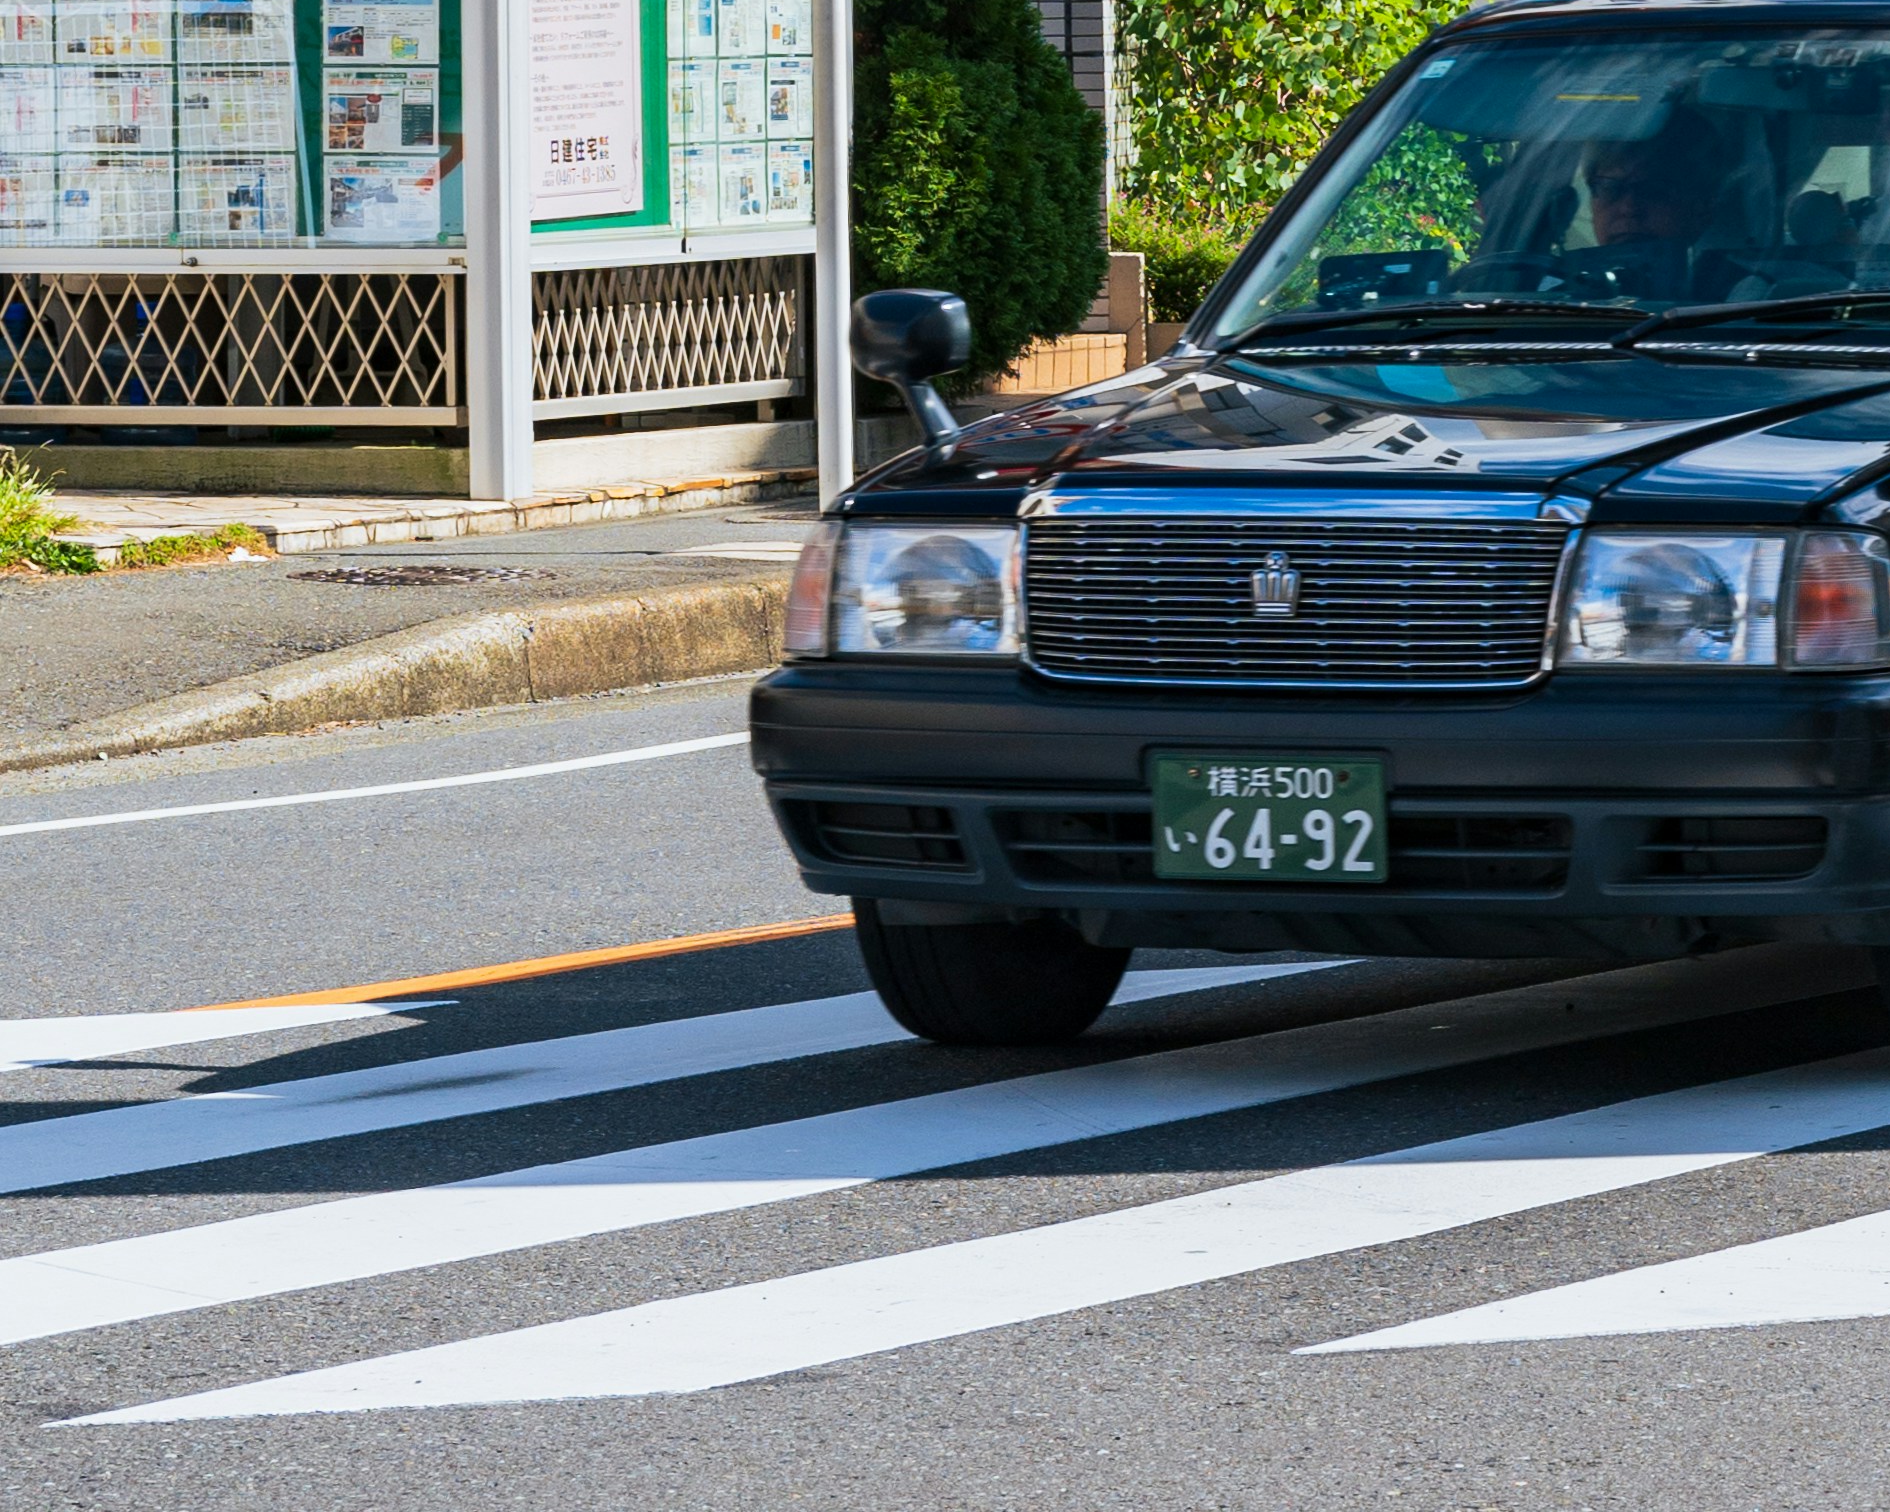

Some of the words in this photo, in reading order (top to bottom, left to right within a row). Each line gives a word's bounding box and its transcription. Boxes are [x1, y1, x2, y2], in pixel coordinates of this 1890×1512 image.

[1207, 766, 1333, 799] 横浜500
[1163, 826, 1199, 853] い
[1204, 808, 1375, 871] 64-92
